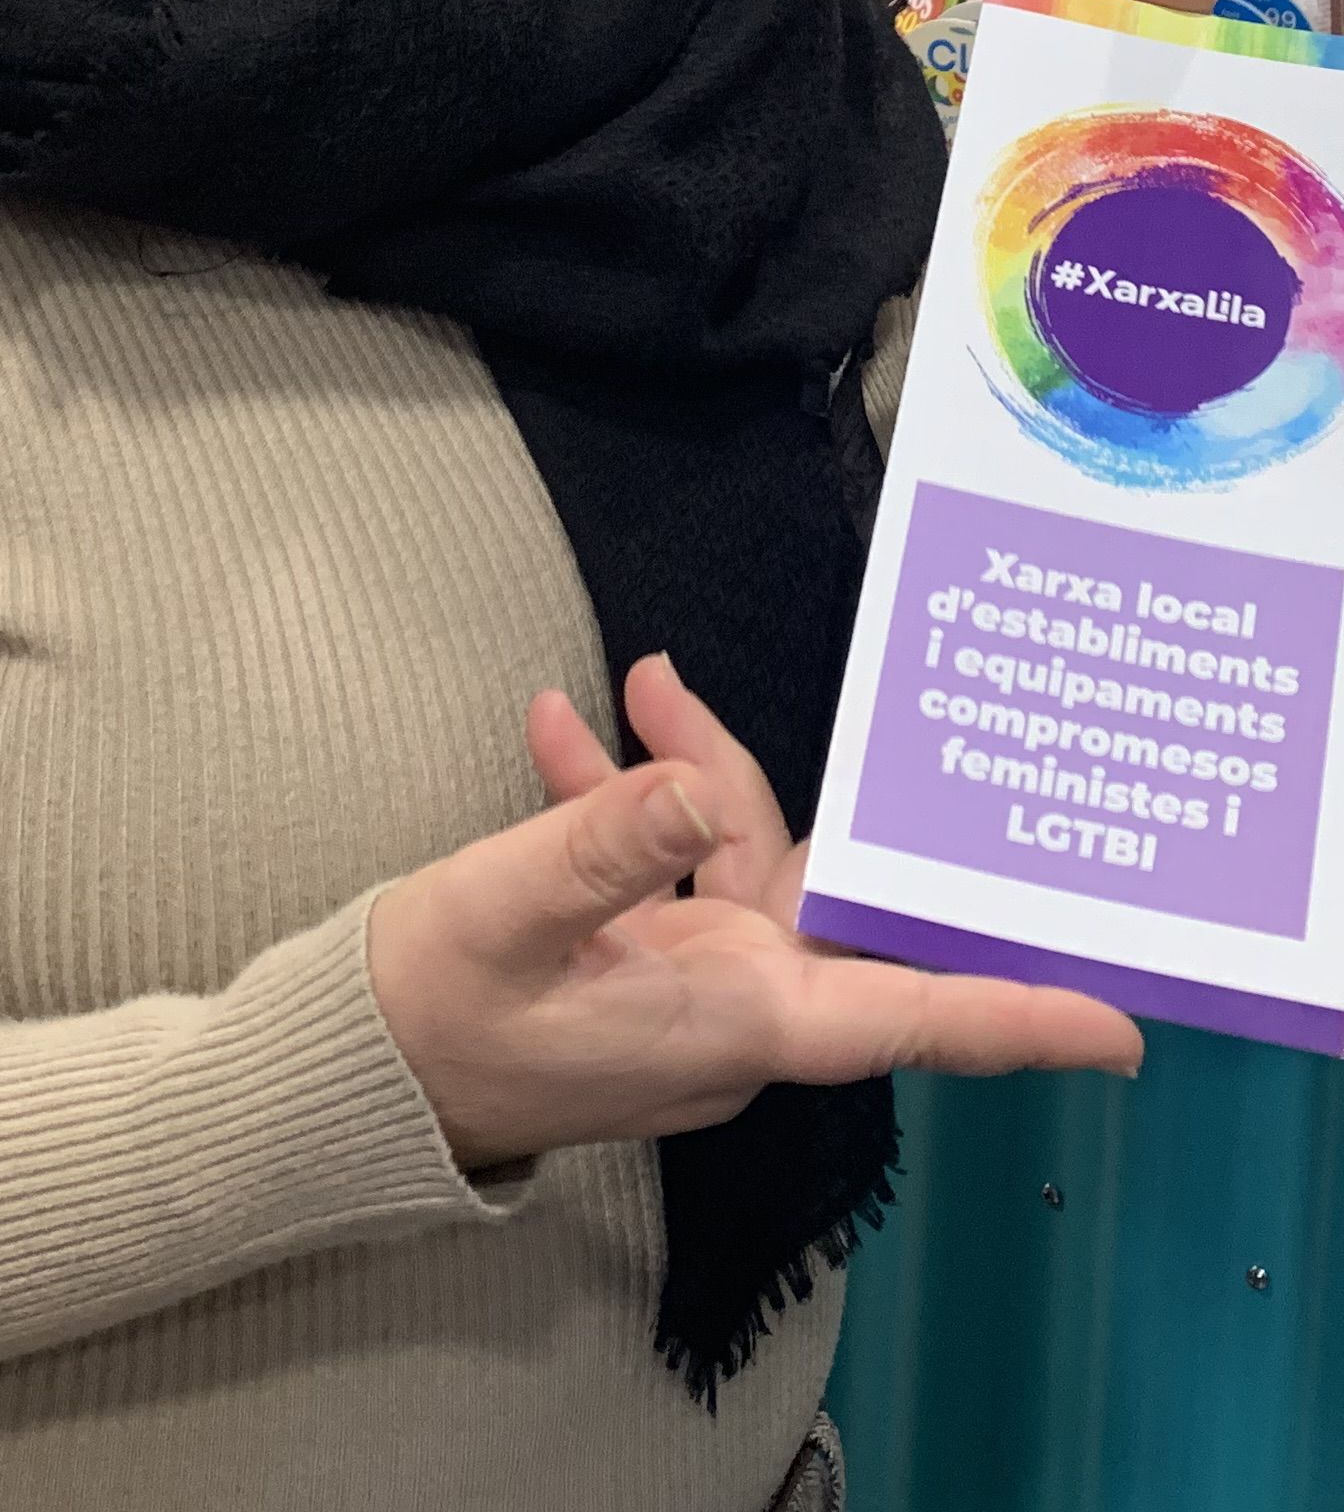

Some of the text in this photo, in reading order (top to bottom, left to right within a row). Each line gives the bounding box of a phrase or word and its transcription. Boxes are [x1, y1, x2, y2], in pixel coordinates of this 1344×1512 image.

[1050, 259, 1267, 329] #XarxaLila
[926, 585, 1300, 696] d'establiments
[980, 547, 1257, 640] Xarxa local
[925, 626, 1287, 744] i equipaments
[919, 688, 1279, 793] compromesos
[941, 735, 1242, 837] feministes i
[1006, 803, 1158, 872] LGTBI
